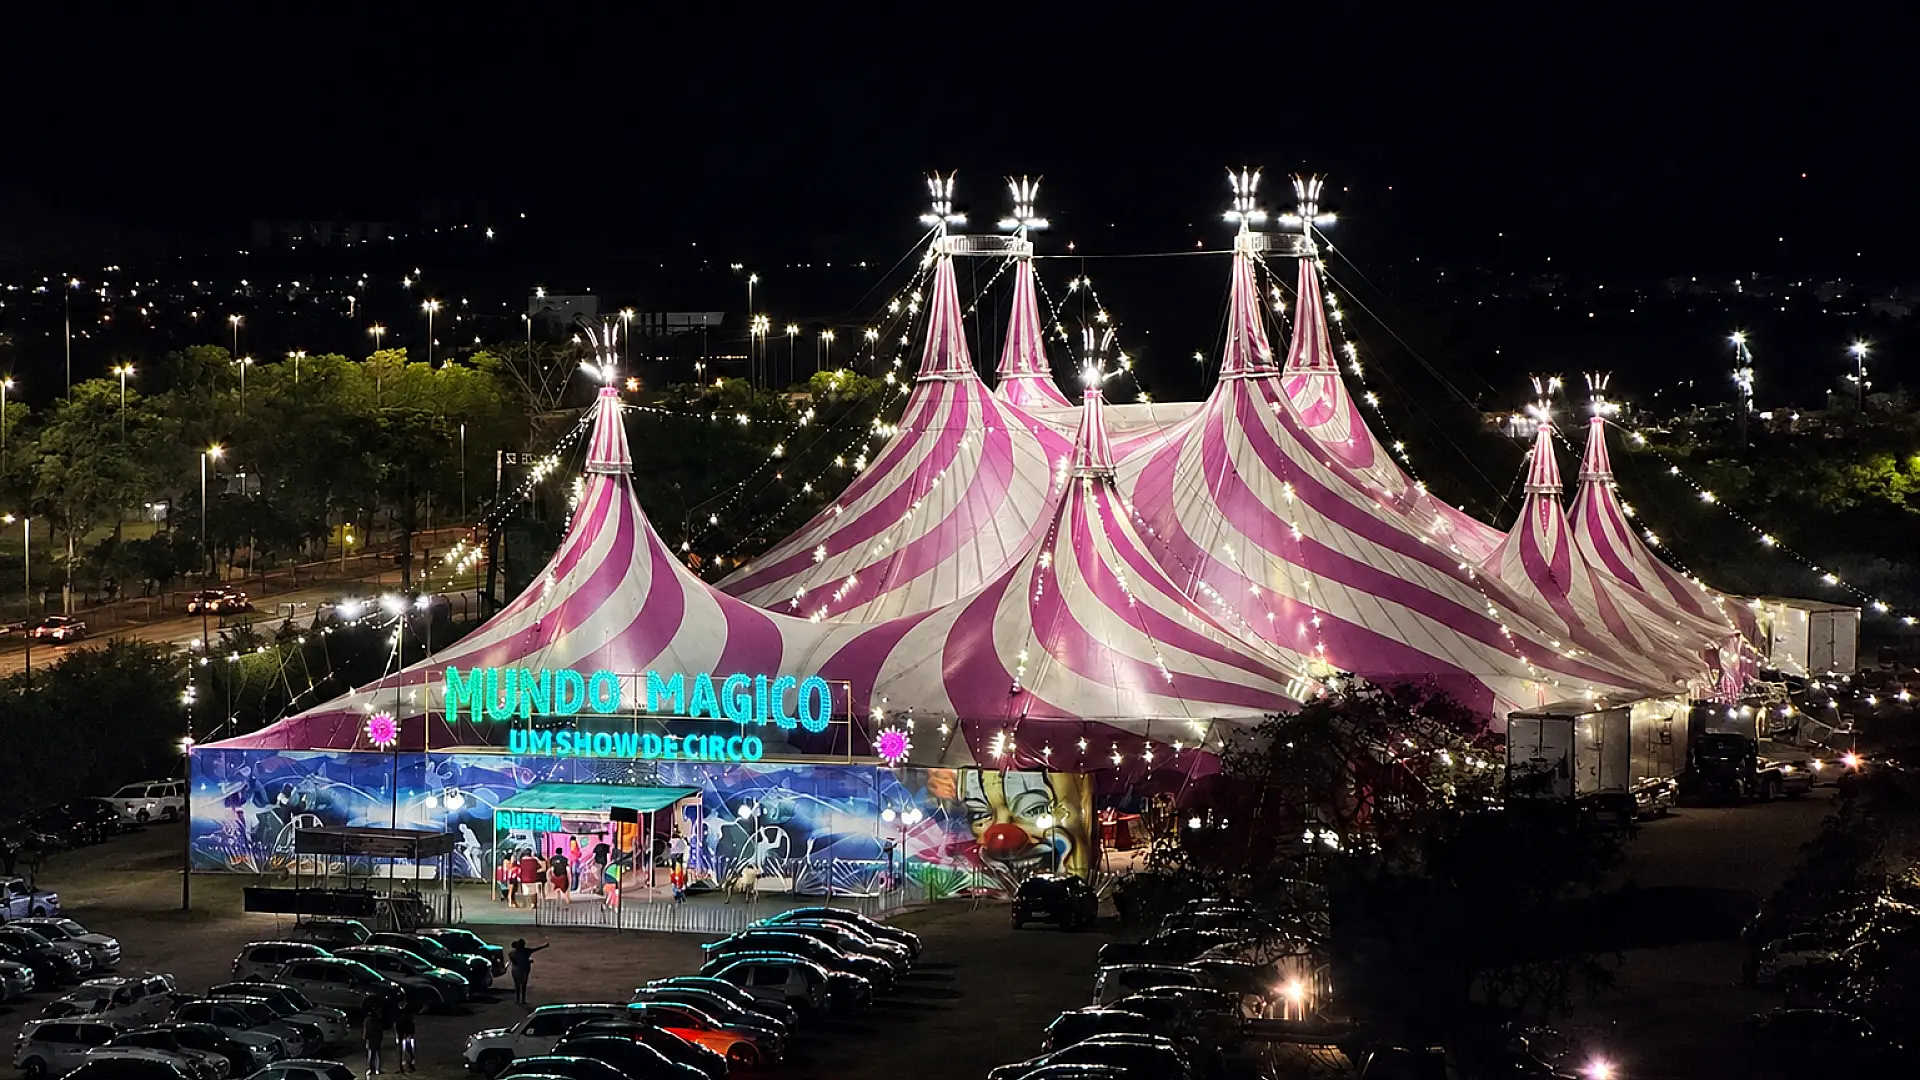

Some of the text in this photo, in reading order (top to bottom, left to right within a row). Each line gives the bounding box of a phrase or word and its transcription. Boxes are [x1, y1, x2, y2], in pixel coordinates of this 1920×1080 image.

[445, 666, 832, 733] MUNDO MAGICO
[509, 729, 764, 762] UM SHOW DE CIRCO
